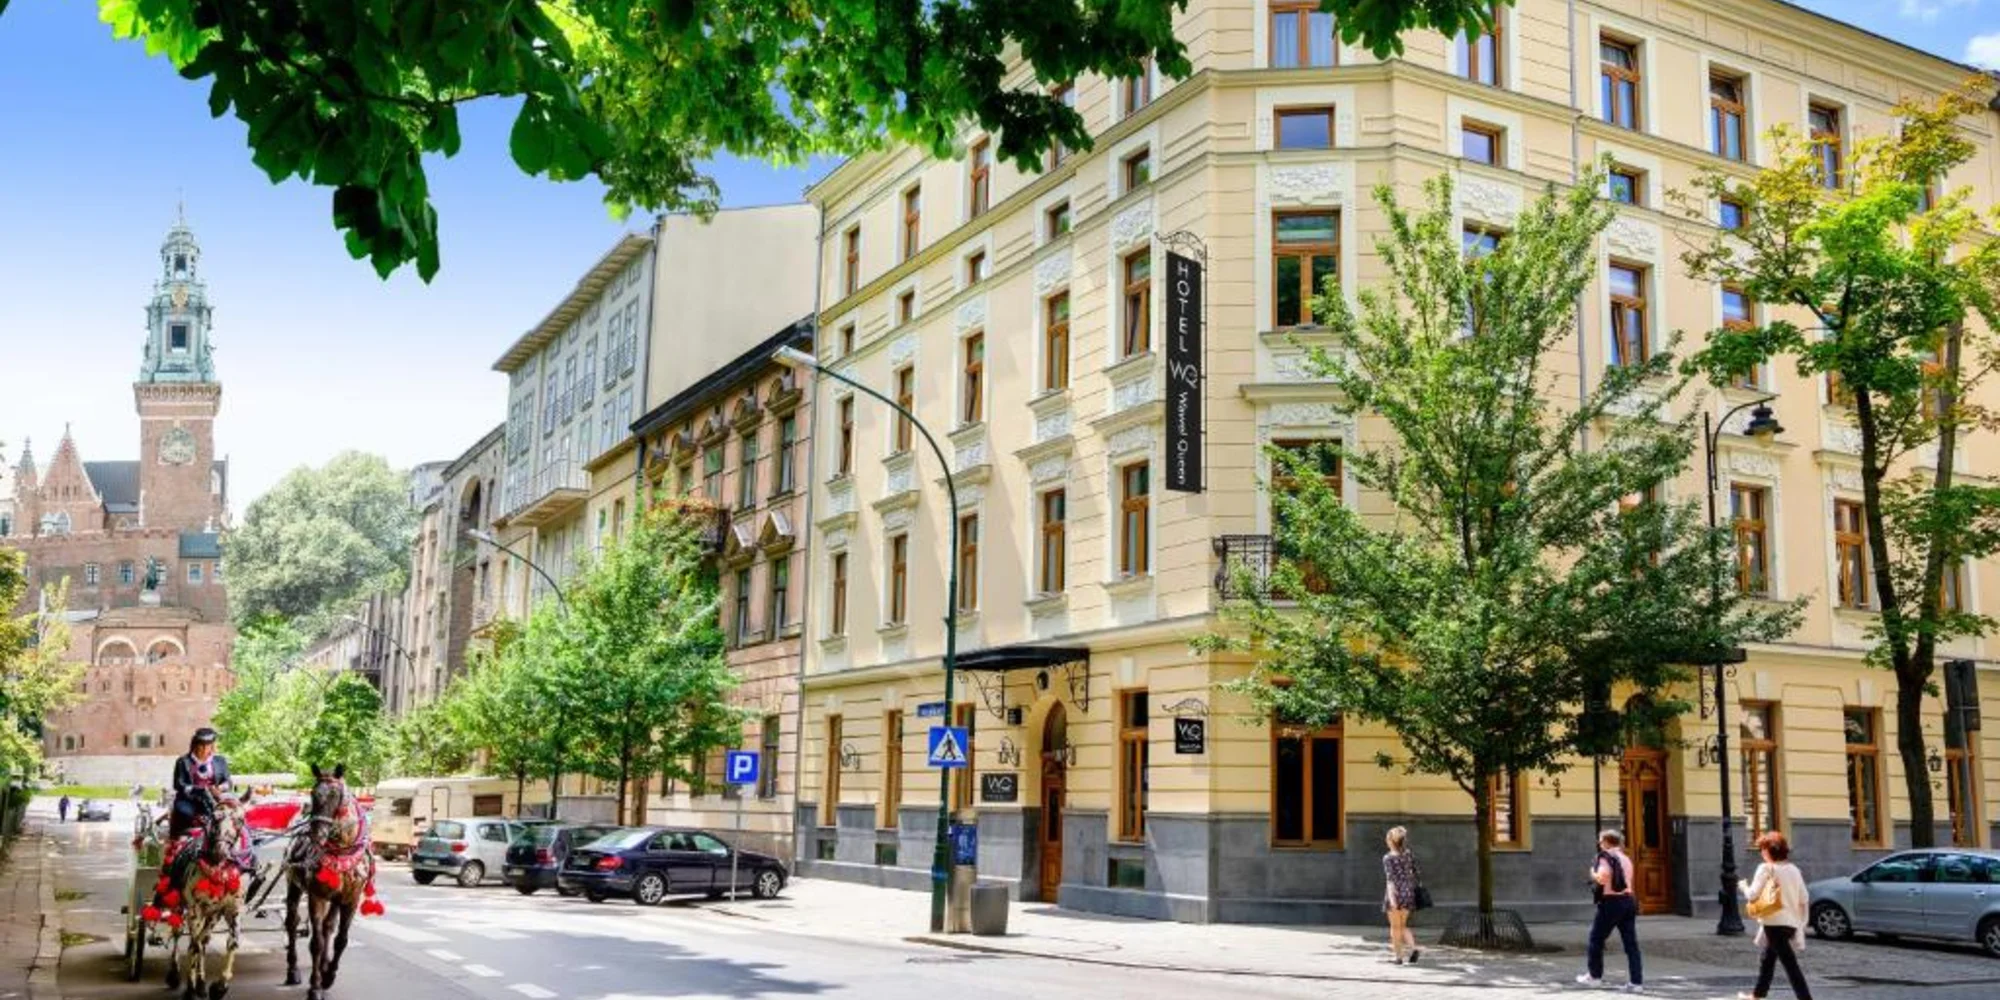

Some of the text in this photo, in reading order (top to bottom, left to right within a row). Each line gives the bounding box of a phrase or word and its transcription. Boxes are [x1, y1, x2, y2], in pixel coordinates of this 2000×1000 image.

[1176, 260, 1191, 353] HOTEL
[1176, 391, 1189, 485] Wawel Queen
[734, 755, 752, 779] P
